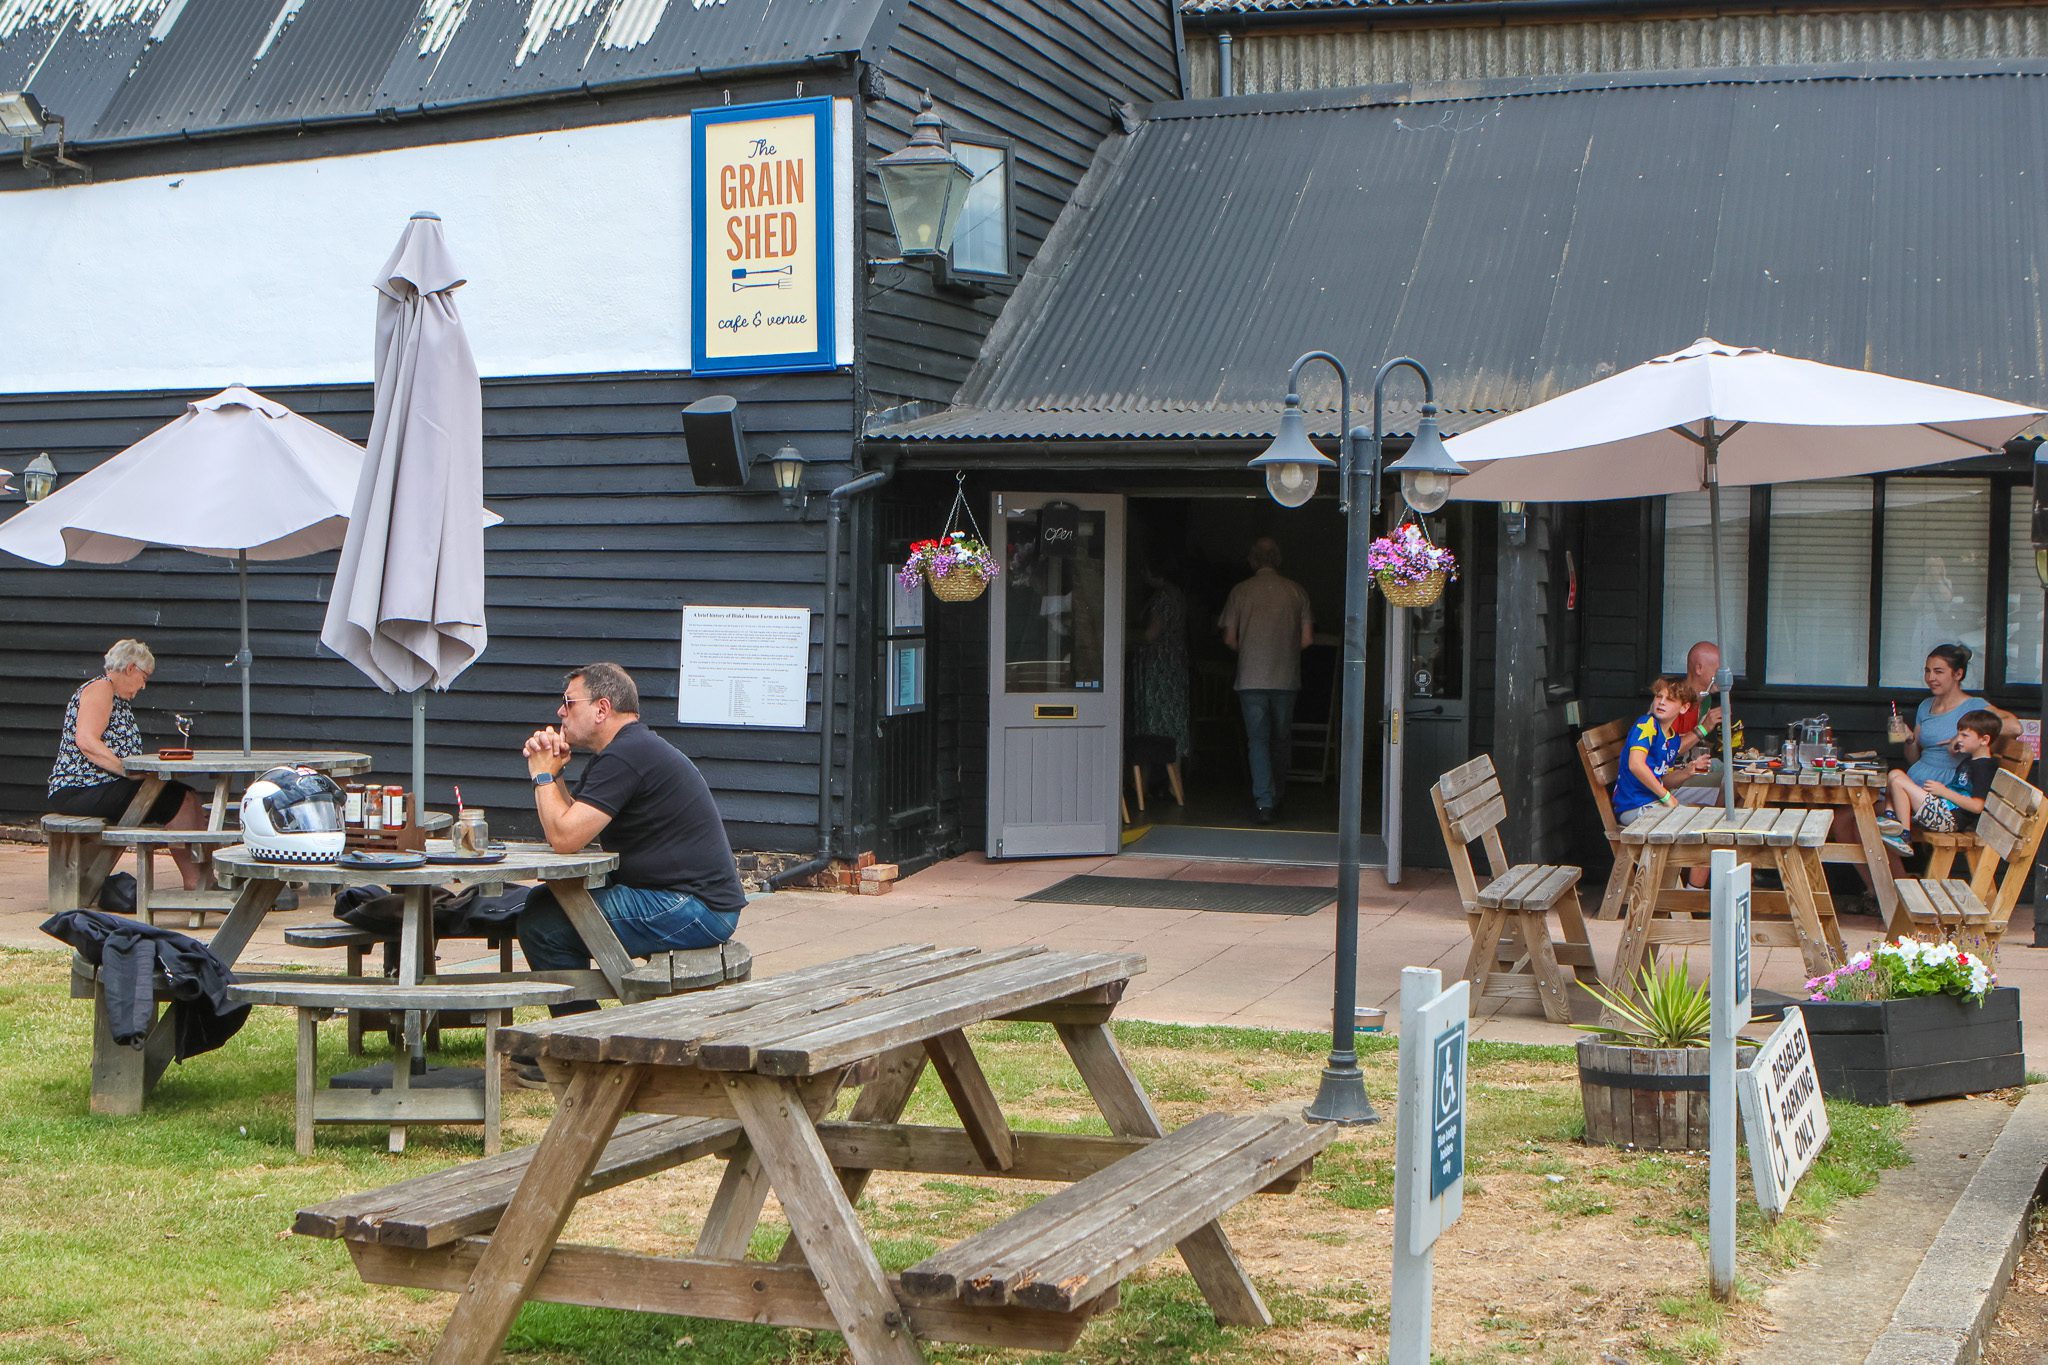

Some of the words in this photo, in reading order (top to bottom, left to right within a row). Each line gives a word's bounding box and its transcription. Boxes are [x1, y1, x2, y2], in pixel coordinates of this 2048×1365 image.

[748, 138, 777, 158] The
[720, 158, 804, 210] GRAIN
[726, 212, 798, 262] SHED
[718, 314, 748, 332] cafe
[752, 310, 762, 328] &
[767, 312, 808, 326] venue
[1772, 1027, 1806, 1093] DISABLED
[1780, 1065, 1814, 1131] PARKING
[1794, 1108, 1816, 1160] ONLY
